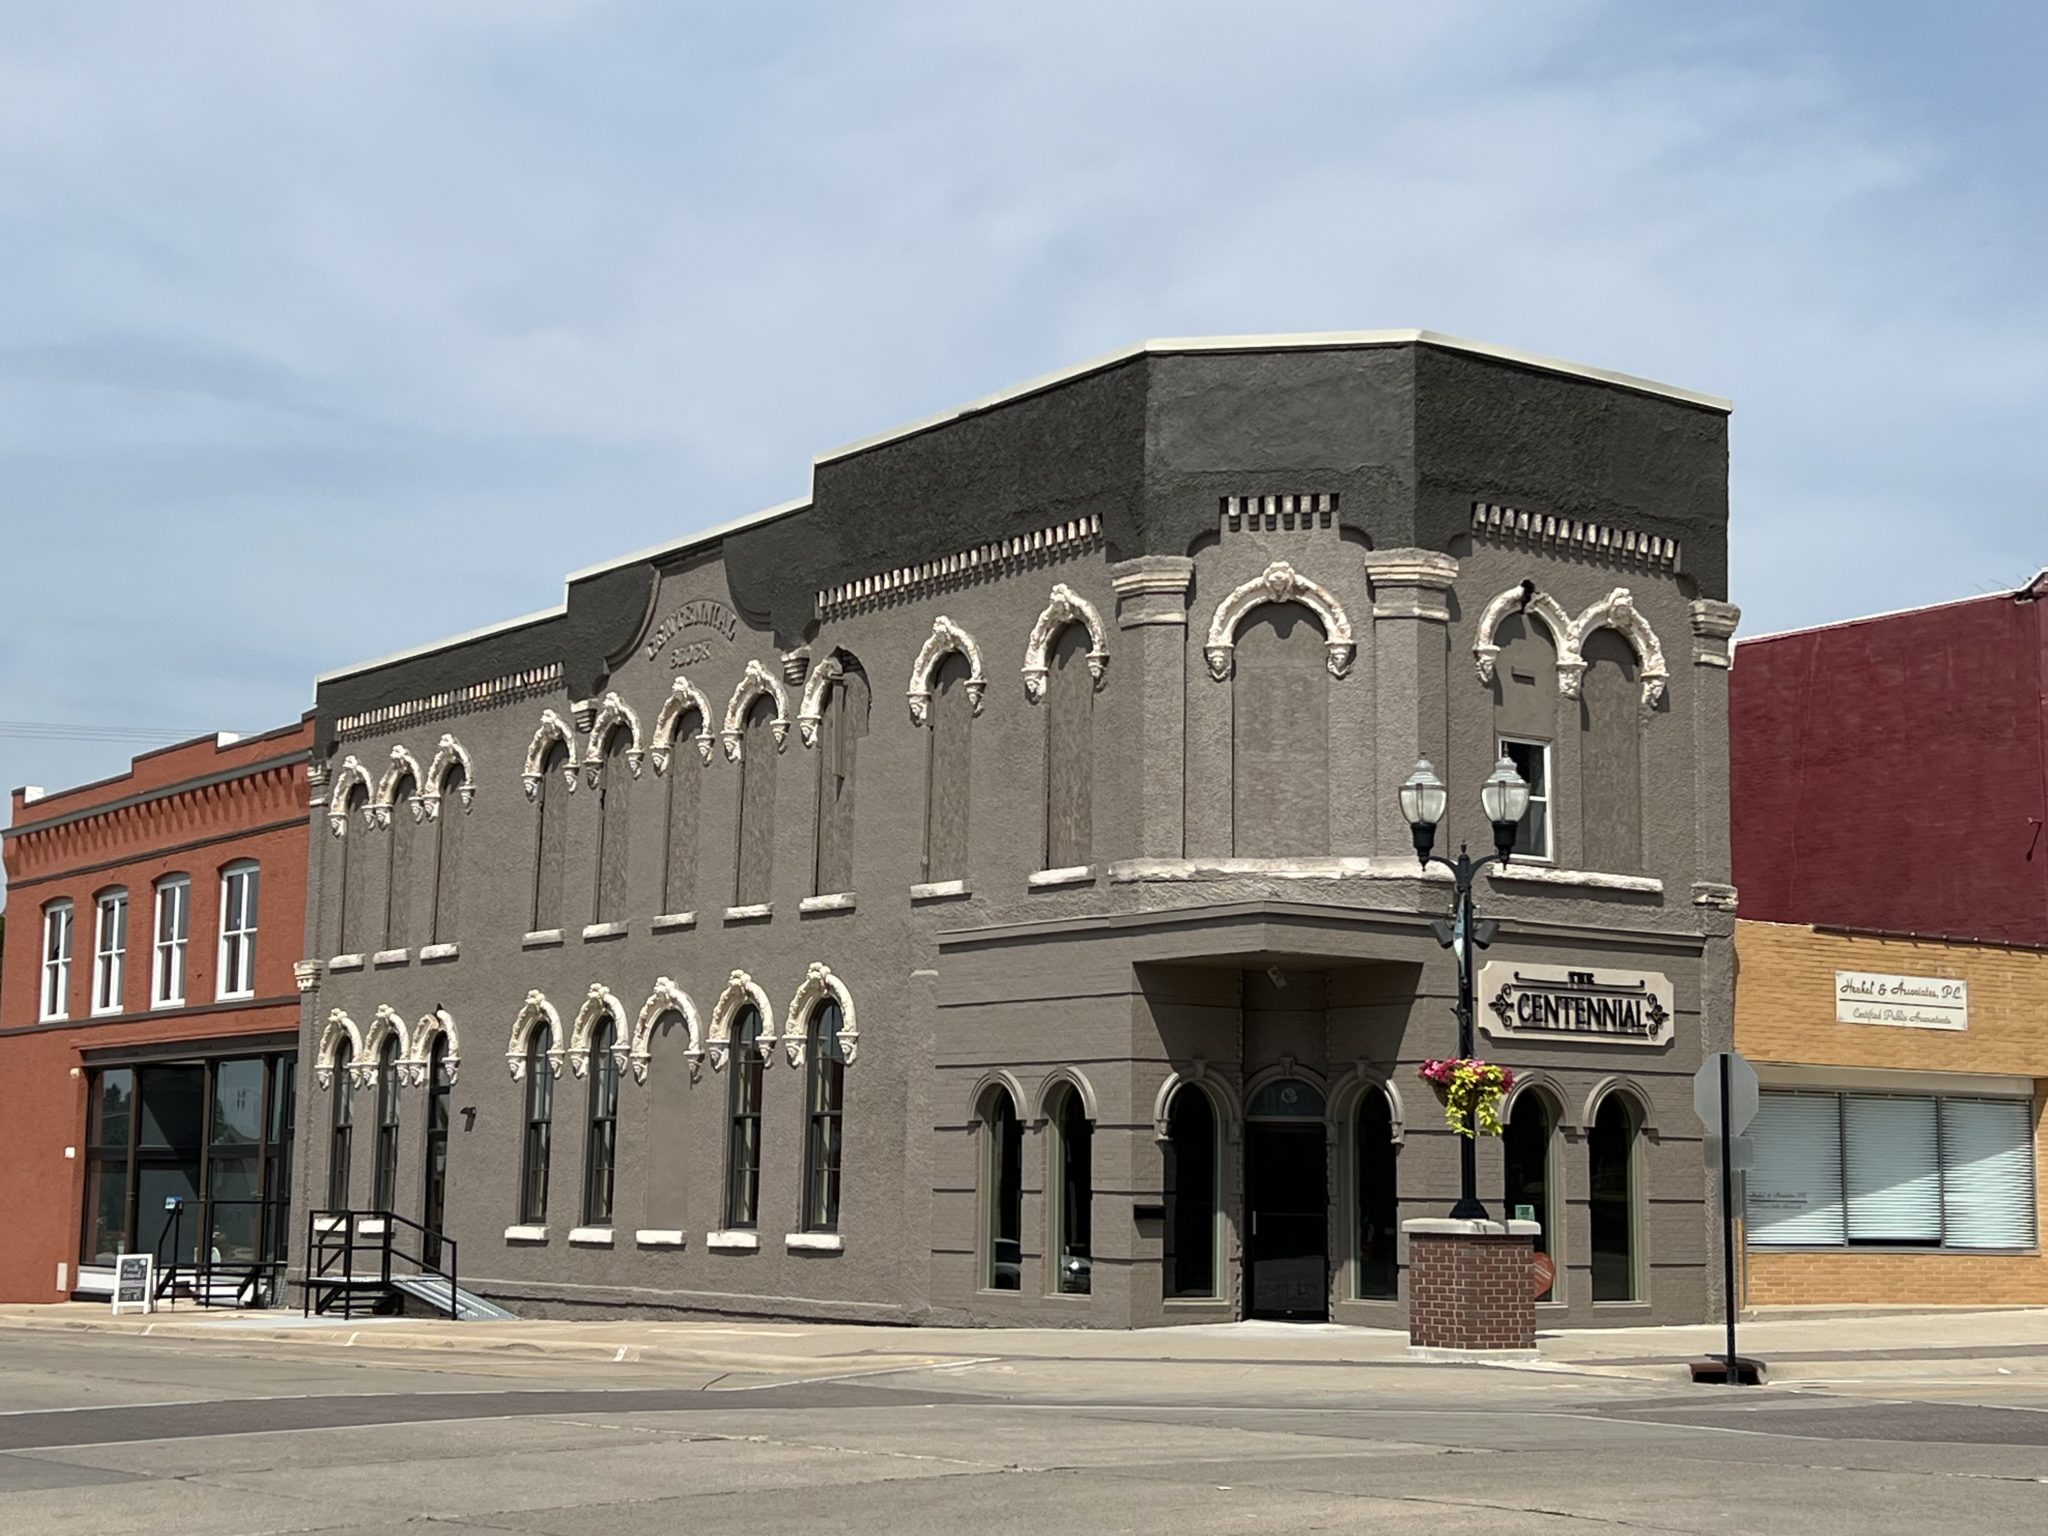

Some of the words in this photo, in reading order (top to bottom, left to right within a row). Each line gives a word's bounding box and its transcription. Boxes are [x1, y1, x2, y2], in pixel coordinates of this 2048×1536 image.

[646, 602, 737, 662] CENTENNIAL
[1567, 971, 1595, 986] THE
[1877, 983, 1888, 996] &
[1517, 992, 1647, 1028] CENTENNIAL
[1883, 1008, 1908, 1022] Public
